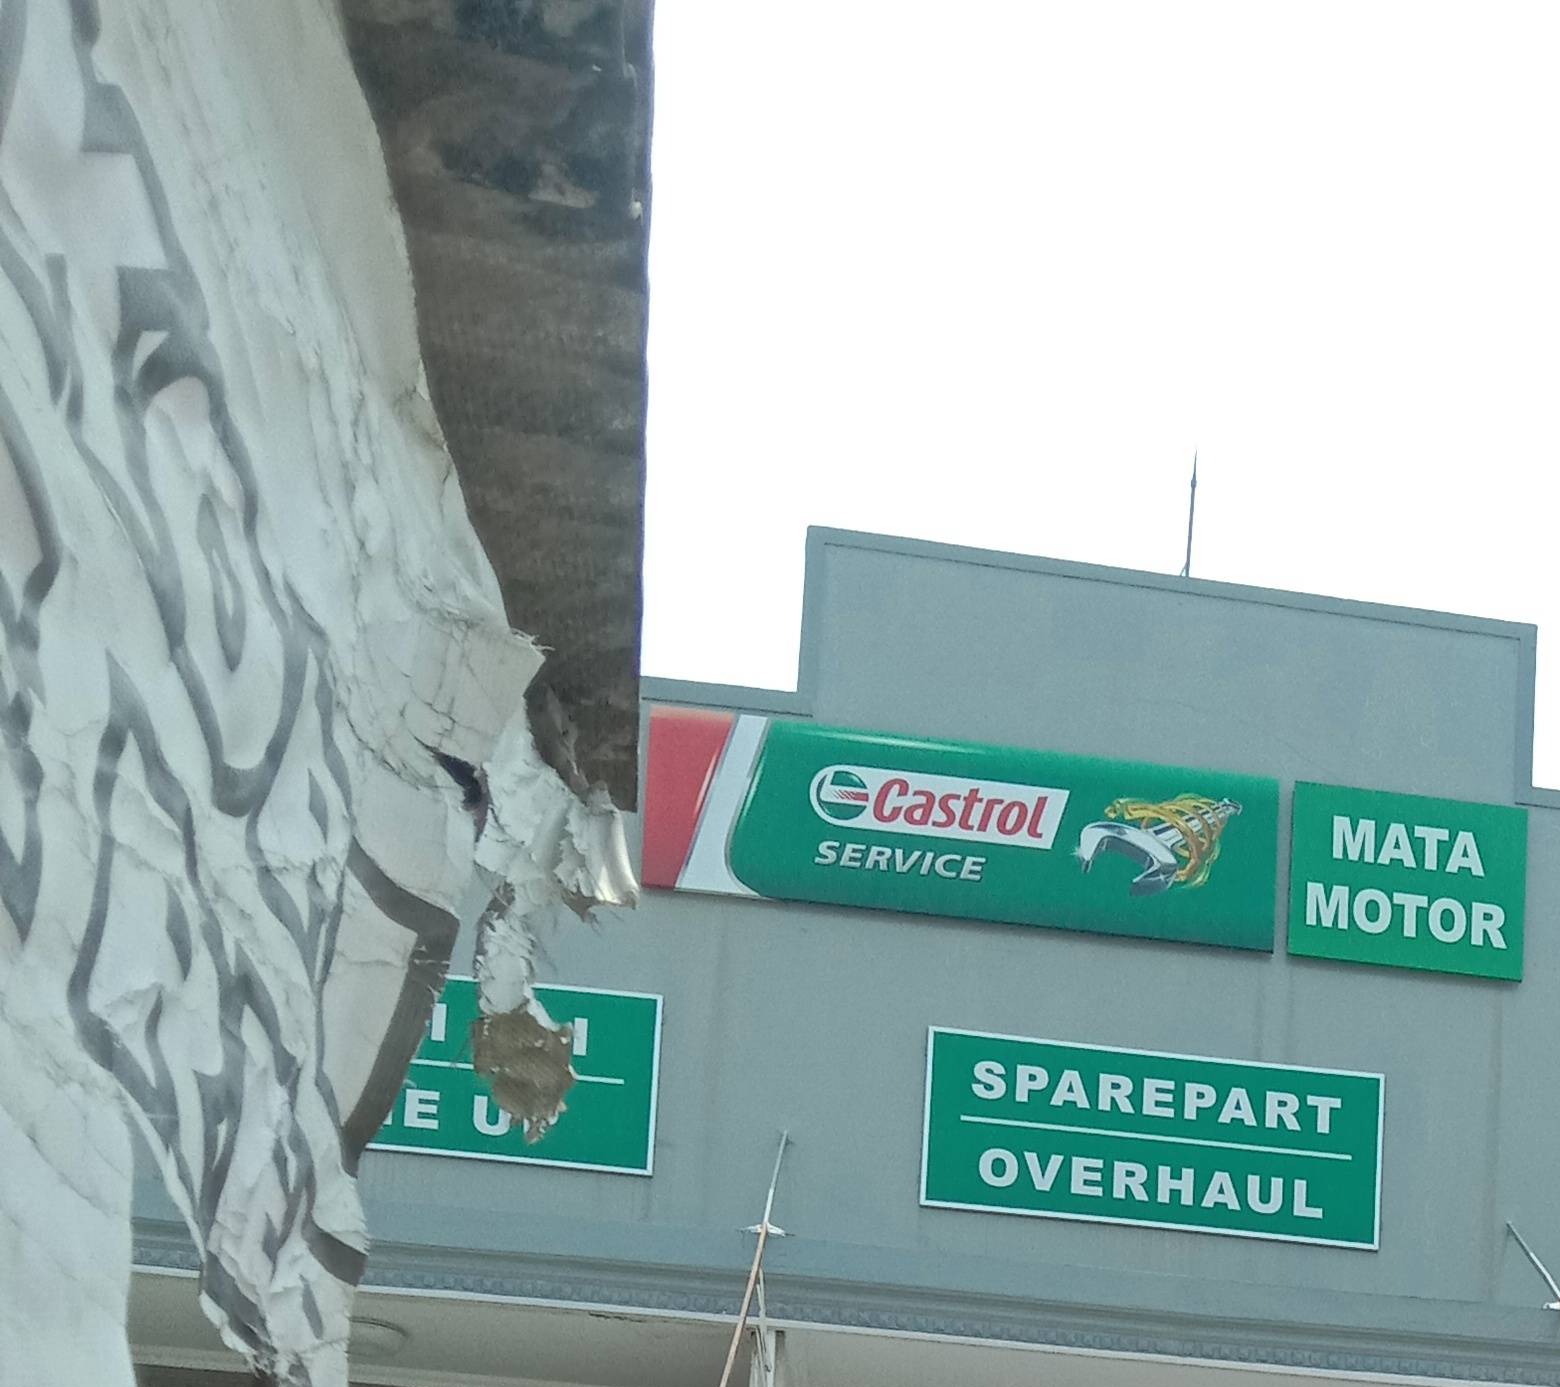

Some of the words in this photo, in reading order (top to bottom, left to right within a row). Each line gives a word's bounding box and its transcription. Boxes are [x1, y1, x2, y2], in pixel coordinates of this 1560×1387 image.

[871, 777, 1049, 840] Castrol
[813, 840, 987, 883] SERVICE
[1331, 815, 1486, 878] MATA
[1304, 883, 1509, 951] MOTOR
[971, 1060, 1343, 1135] SPAREPART
[977, 1148, 1325, 1221] OVERHAUL
